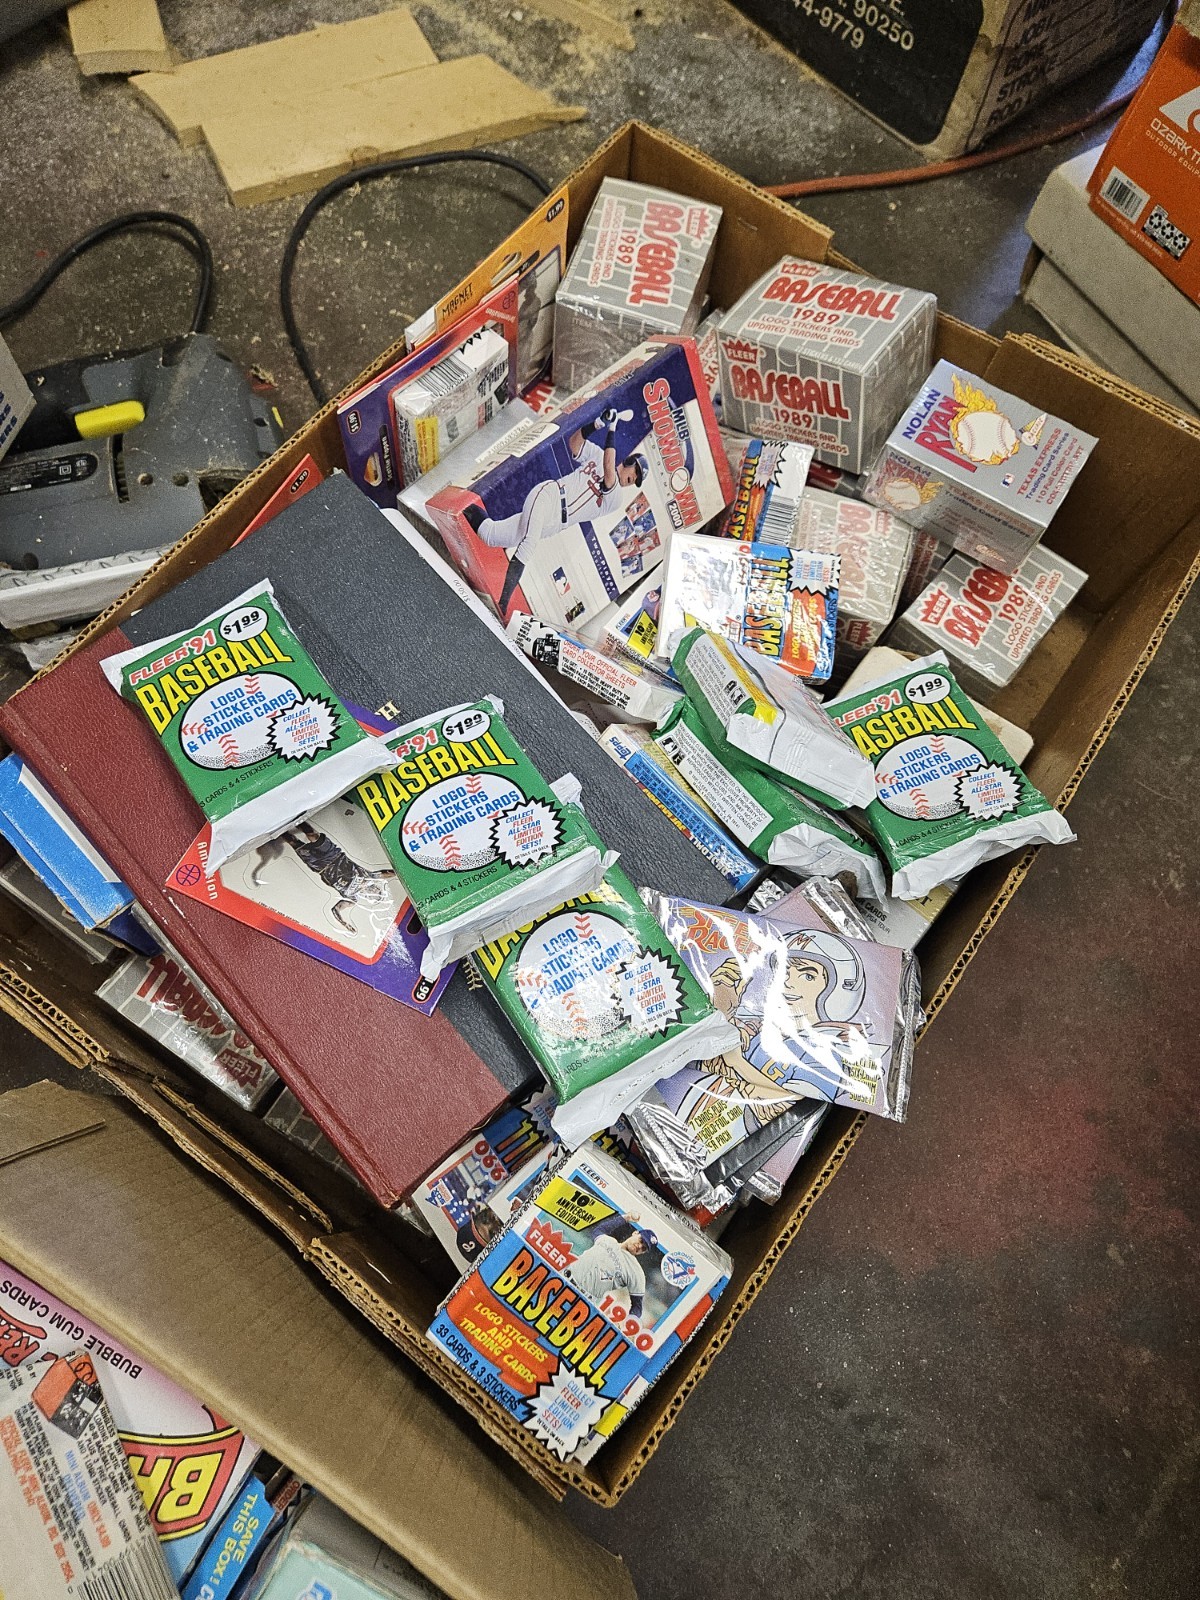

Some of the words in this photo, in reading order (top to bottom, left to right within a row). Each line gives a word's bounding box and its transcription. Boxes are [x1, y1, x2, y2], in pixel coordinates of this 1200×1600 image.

[853, 1, 915, 51] 90250
[1146, 130, 1178, 158] OUTDOOR
[548, 200, 564, 220] $1.99
[617, 229, 638, 264] 1989
[628, 200, 685, 305] BASEBALL
[783, 264, 817, 277] FLEER
[442, 282, 474, 316] MAGNET
[763, 277, 900, 320] BASEBALL
[762, 315, 790, 326] LOGO
[793, 320, 832, 333] STICKERS
[834, 329, 855, 338] AND
[793, 308, 841, 325] 1989
[747, 321, 787, 333] UPDATED
[788, 329, 828, 341] TRADING
[830, 335, 861, 347] CARDS
[726, 347, 756, 361] FLEER
[731, 365, 850, 420] BASEBALL
[672, 407, 690, 440] MLB
[773, 408, 813, 428] 1989
[903, 389, 941, 440] NOLAN
[783, 426, 818, 439] STICKERS
[819, 433, 837, 443] AND
[914, 396, 973, 469] RYAN
[1064, 437, 1078, 456] Card
[821, 441, 848, 454] CARDS
[1017, 466, 1038, 495] TEXAS
[1035, 427, 1062, 467] EXPRESS
[889, 451, 931, 477] NOLAN
[1025, 472, 1046, 500] Trading
[1042, 455, 1055, 473] Card
[1053, 432, 1070, 454] Series
[291, 470, 308, 491] $1.99
[727, 455, 760, 540] ASEBALL
[949, 485, 983, 506] TEXAS
[668, 501, 683, 528] 2000
[944, 490, 978, 511] Trading
[978, 508, 1001, 522] Card
[1002, 521, 1031, 538] Series
[743, 556, 791, 657] BASEBALL
[928, 594, 949, 622] FLEER
[998, 584, 1028, 622] 1989
[1011, 626, 1033, 659] UPDATED
[1044, 571, 1062, 595] CARDS
[1005, 623, 1023, 646] LOGO
[130, 630, 216, 684] FLEER'91
[562, 647, 577, 659] CARD
[577, 656, 606, 677] COLLECTOR
[605, 673, 626, 689] SHEETS
[582, 650, 596, 662] YOUR
[597, 659, 619, 677] OFFICIAL
[620, 674, 638, 687] FLEER
[136, 631, 293, 736] BASEBALL
[203, 691, 267, 726] STICKERS
[210, 687, 246, 710] LOGO
[835, 689, 902, 727] LEER'91
[188, 741, 200, 753] &
[197, 714, 255, 747] TRADING
[253, 689, 298, 720] CARDS
[283, 707, 311, 723] COLLECT
[285, 717, 318, 734] ALL-STAR
[291, 714, 311, 726] FLEER
[850, 697, 978, 760] ASEBALL
[291, 723, 319, 737] LIMITED
[293, 728, 321, 743] EDITION
[298, 735, 319, 747] SETS!
[609, 736, 632, 761] Topps
[899, 746, 931, 765] LOGO
[879, 787, 891, 799] &
[890, 766, 941, 795] TRADING
[941, 753, 981, 778] CARDS
[894, 751, 951, 780] STICKERS
[968, 772, 995, 783] COLLECT
[205, 786, 228, 804] CARDS
[239, 760, 275, 783] STICKERS
[357, 731, 517, 832] BASEBALL
[971, 782, 1002, 794] ALL-STAR
[425, 791, 490, 827] STICKERS
[431, 786, 468, 809] LOGO
[984, 798, 1004, 807] SETS!
[408, 840, 421, 853] &
[418, 814, 477, 846] TRADING
[476, 791, 521, 819] CARDS
[506, 808, 534, 824] COLLECT
[508, 820, 541, 837] ALL-STAR
[512, 816, 534, 828] FLEER
[514, 826, 542, 841] LIMITED
[516, 831, 544, 847] EDITION
[522, 839, 542, 851] SETS!
[424, 889, 450, 906] CARDS
[462, 867, 498, 887] STICKERS
[864, 903, 887, 922] CARDS
[877, 921, 891, 934] TOUR
[543, 928, 579, 957] LOGO
[637, 985, 664, 1002] LIMITED
[640, 991, 667, 1009] EDITION
[646, 1001, 666, 1015] SETS!
[219, 1053, 258, 1079] FLEER
[696, 1108, 714, 1128] CARDS
[711, 1099, 728, 1116] PLUS
[702, 1115, 730, 1140] GOLD-FOIL
[726, 1105, 744, 1122] CARD
[715, 1130, 733, 1147] PACK
[555, 1210, 580, 1226] EDITION
[556, 1197, 597, 1224] ANNIVERSARY
[530, 1228, 568, 1267] FLEER
[1, 1280, 50, 1319] CARDS
[50, 1311, 85, 1342] GUM
[473, 1303, 503, 1326] LOGO
[502, 1323, 549, 1362] STICKERS
[492, 1247, 630, 1390] BASEBALL
[600, 1295, 654, 1351] 1990
[460, 1318, 505, 1357] TRADING
[502, 1354, 538, 1384] CARDS
[487, 1326, 514, 1348] AND
[84, 1334, 143, 1380] BUBBLE
[436, 1324, 449, 1339] 33
[446, 1336, 473, 1362] CARDS
[483, 1374, 521, 1411] STICKERS
[554, 1396, 580, 1421] LIMITED
[560, 1386, 582, 1409] FLEER
[567, 1381, 596, 1408] COLLECT
[542, 1408, 562, 1431] SETS!
[549, 1404, 575, 1430] EDITION
[94, 1414, 109, 1443] LOADING
[107, 1444, 121, 1471] PLASTIC
[95, 1440, 111, 1473] BASEBALL
[65, 1450, 78, 1471] MINI
[74, 1470, 91, 1502] ALBUM
[120, 1458, 133, 1481] ALBUM
[277, 1480, 300, 1511] ORDER
[104, 1485, 122, 1519] BASEBALL
[117, 1518, 132, 1543] CARDS
[232, 1493, 259, 1534] THIS
[233, 1516, 260, 1564] SAVE
